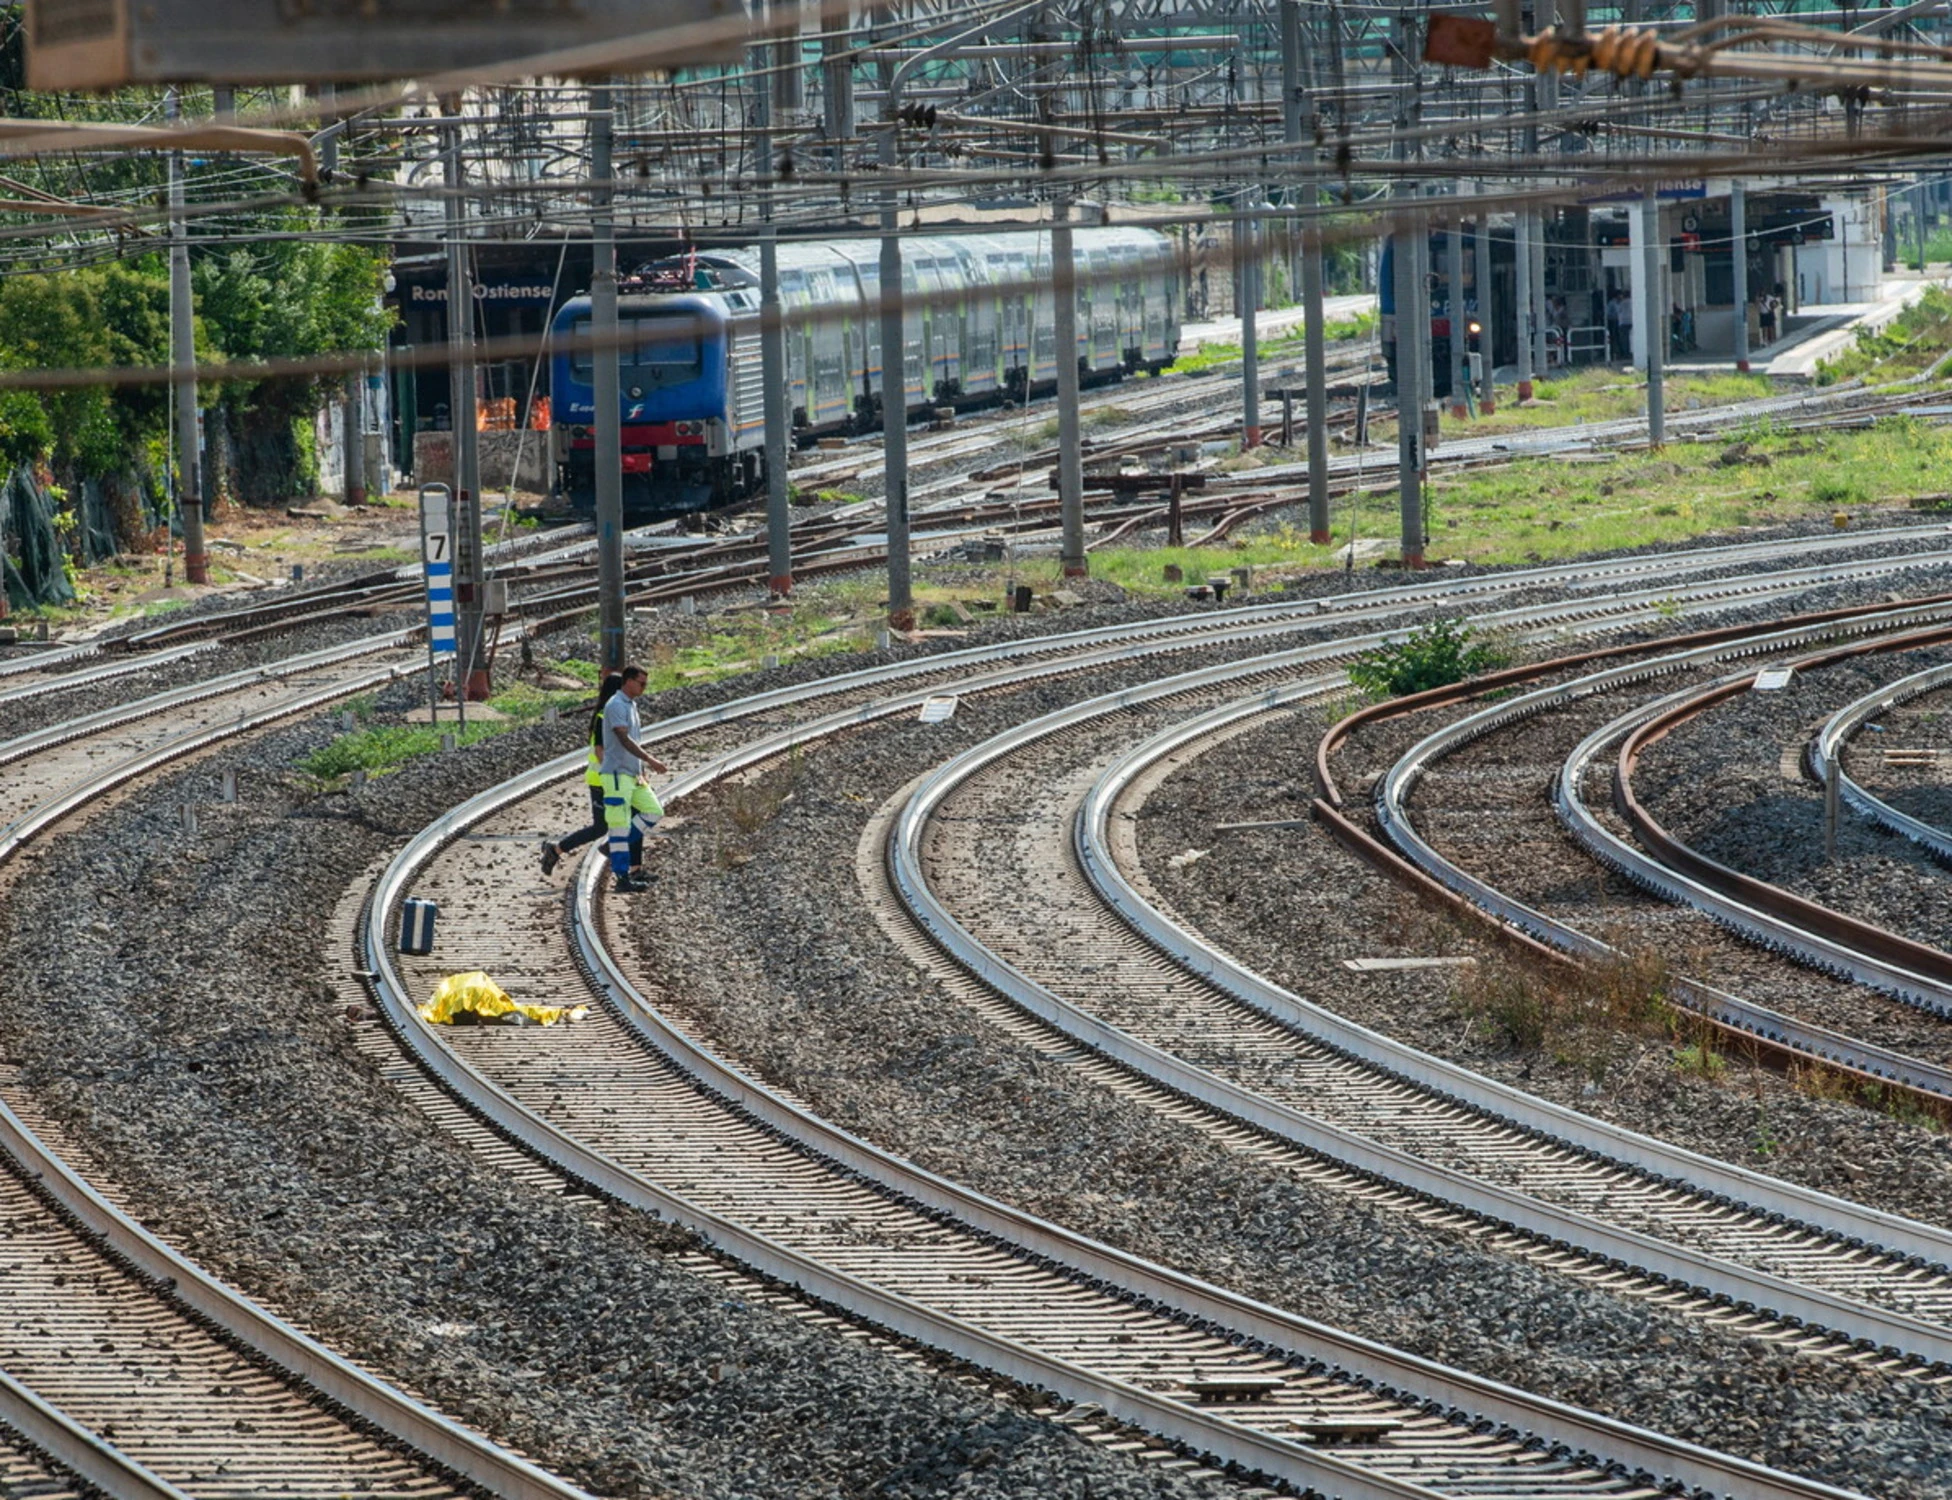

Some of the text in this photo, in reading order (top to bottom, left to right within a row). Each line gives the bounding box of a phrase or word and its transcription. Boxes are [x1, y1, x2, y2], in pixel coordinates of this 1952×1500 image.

[412, 283, 553, 301] Rom Ostiense
[430, 535, 446, 560] 7
